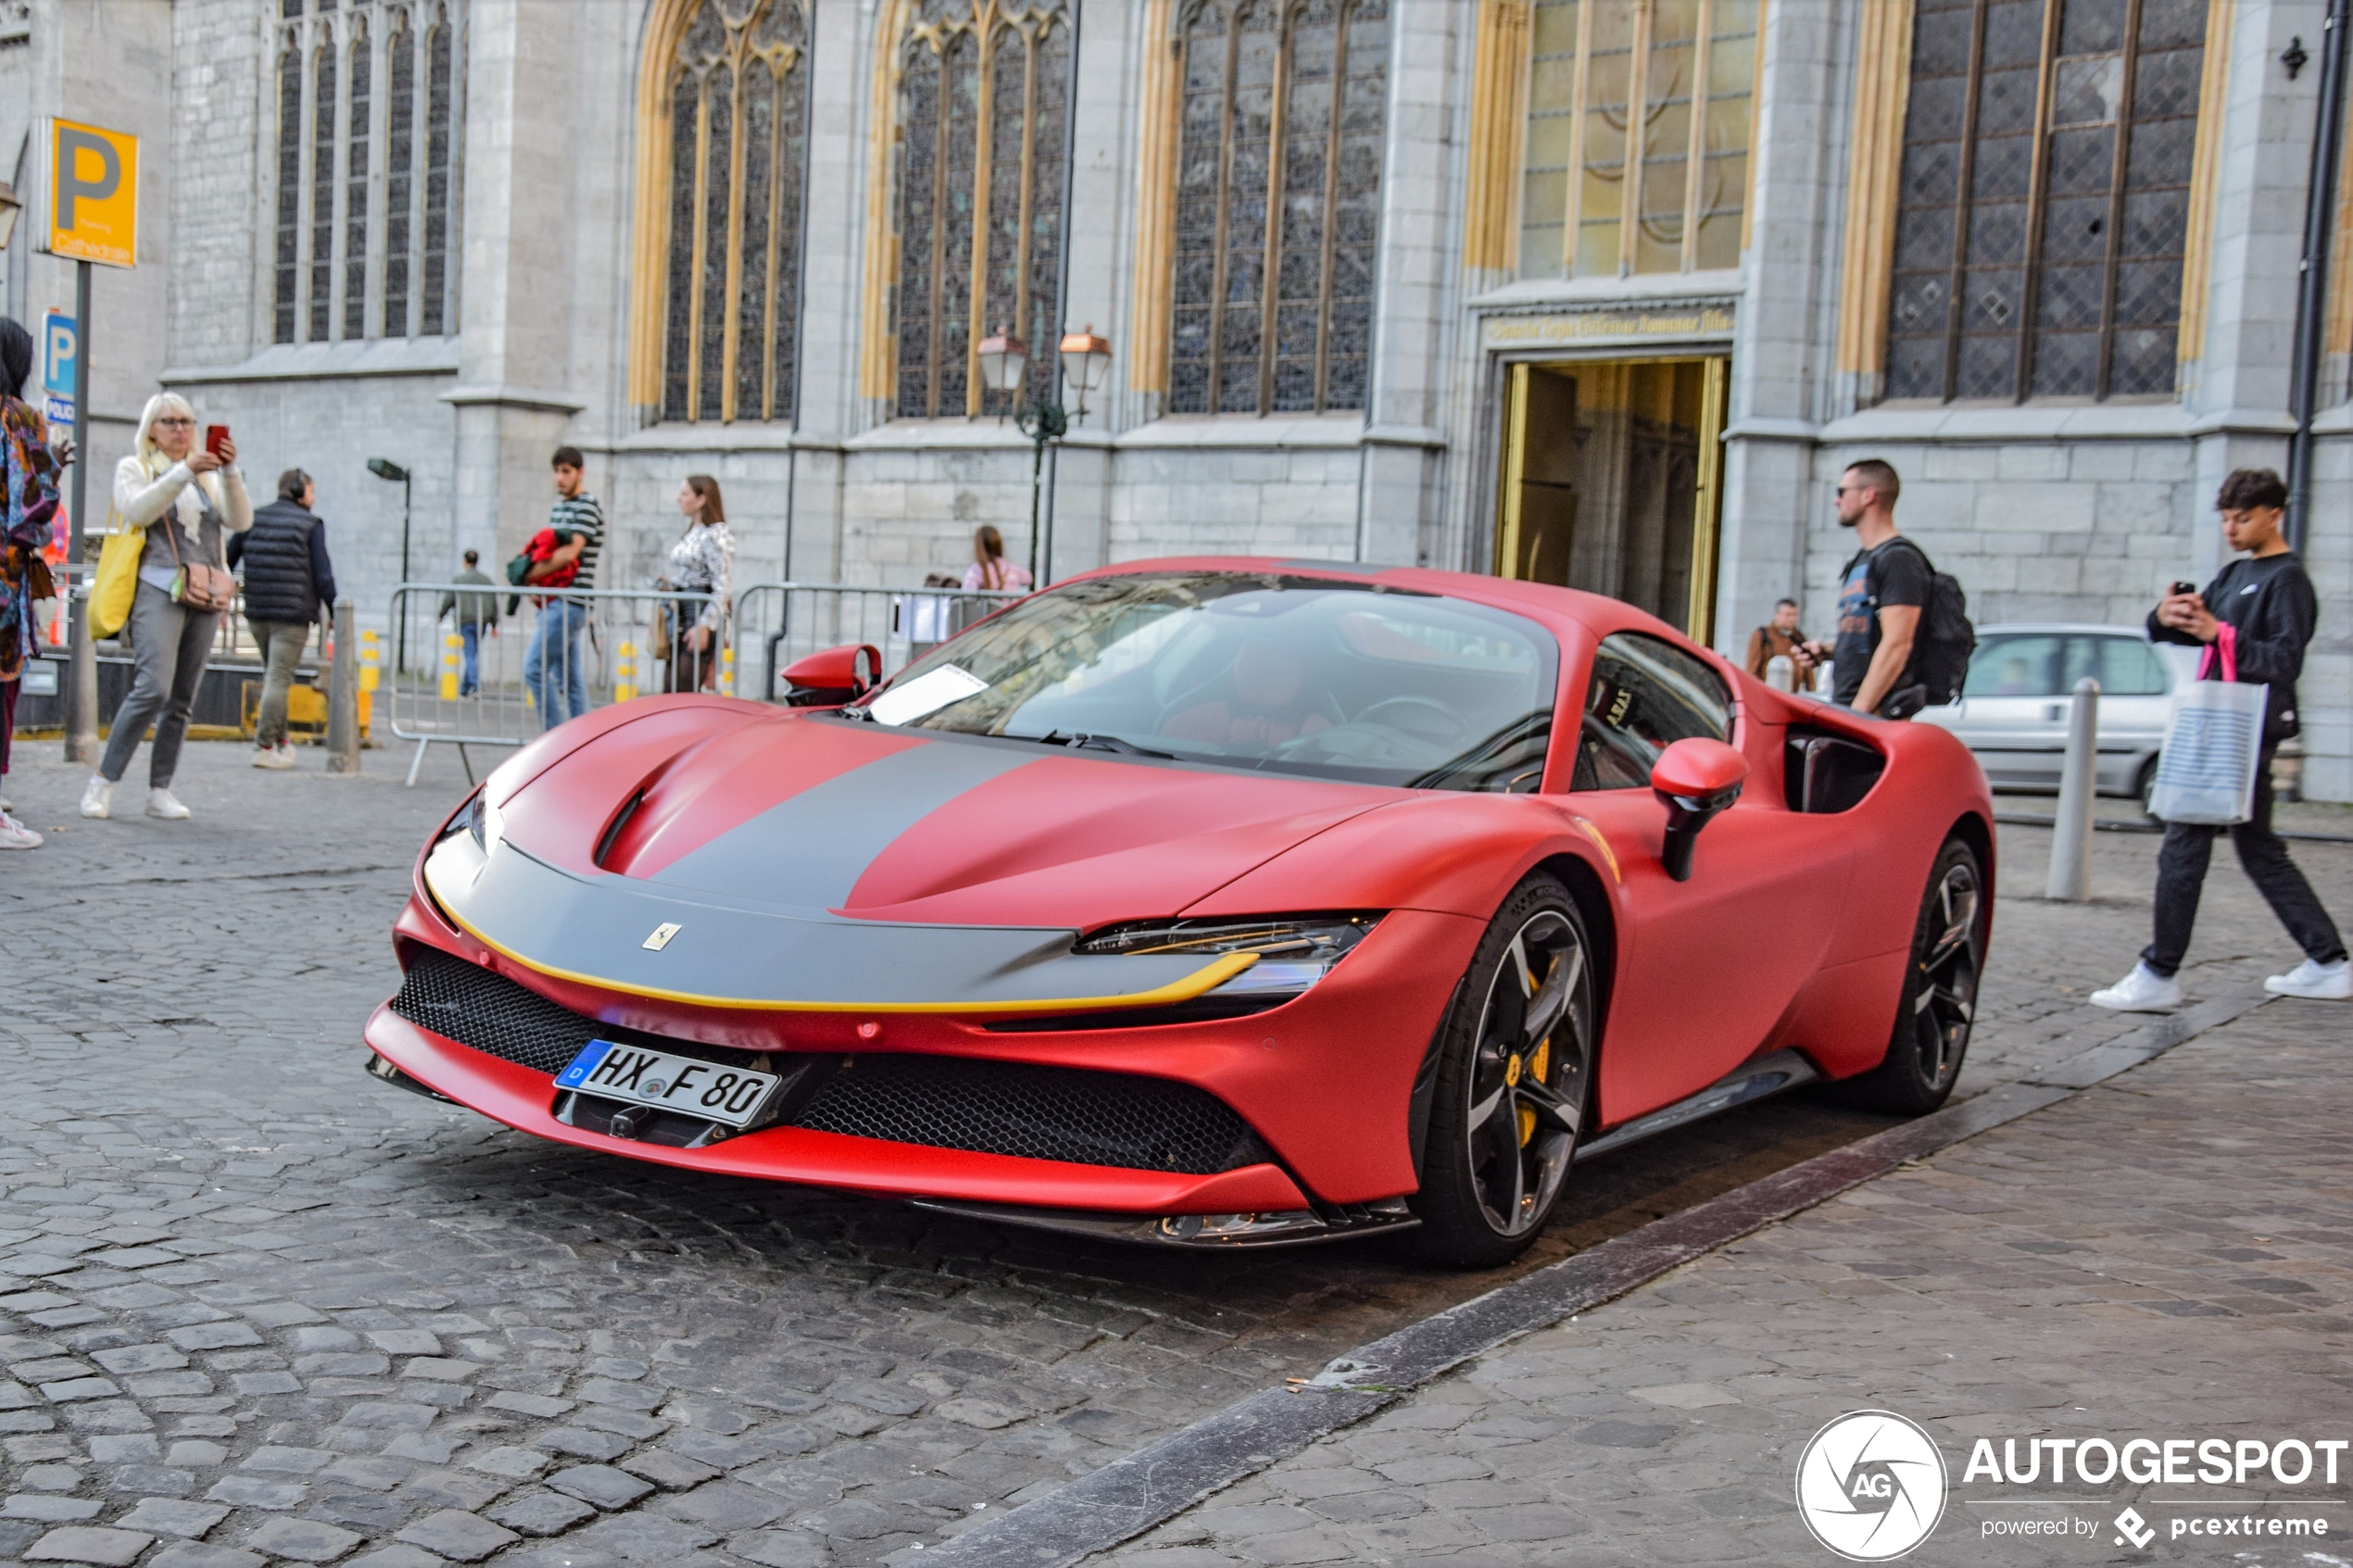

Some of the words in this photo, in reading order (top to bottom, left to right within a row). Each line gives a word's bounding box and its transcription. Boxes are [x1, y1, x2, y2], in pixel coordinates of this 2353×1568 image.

[57, 128, 120, 231] P
[50, 325, 76, 381] P
[48, 402, 74, 420] POLIC
[569, 1067, 584, 1079] D
[588, 1048, 660, 1091] HX
[663, 1064, 709, 1098] F
[700, 1073, 763, 1113] 80
